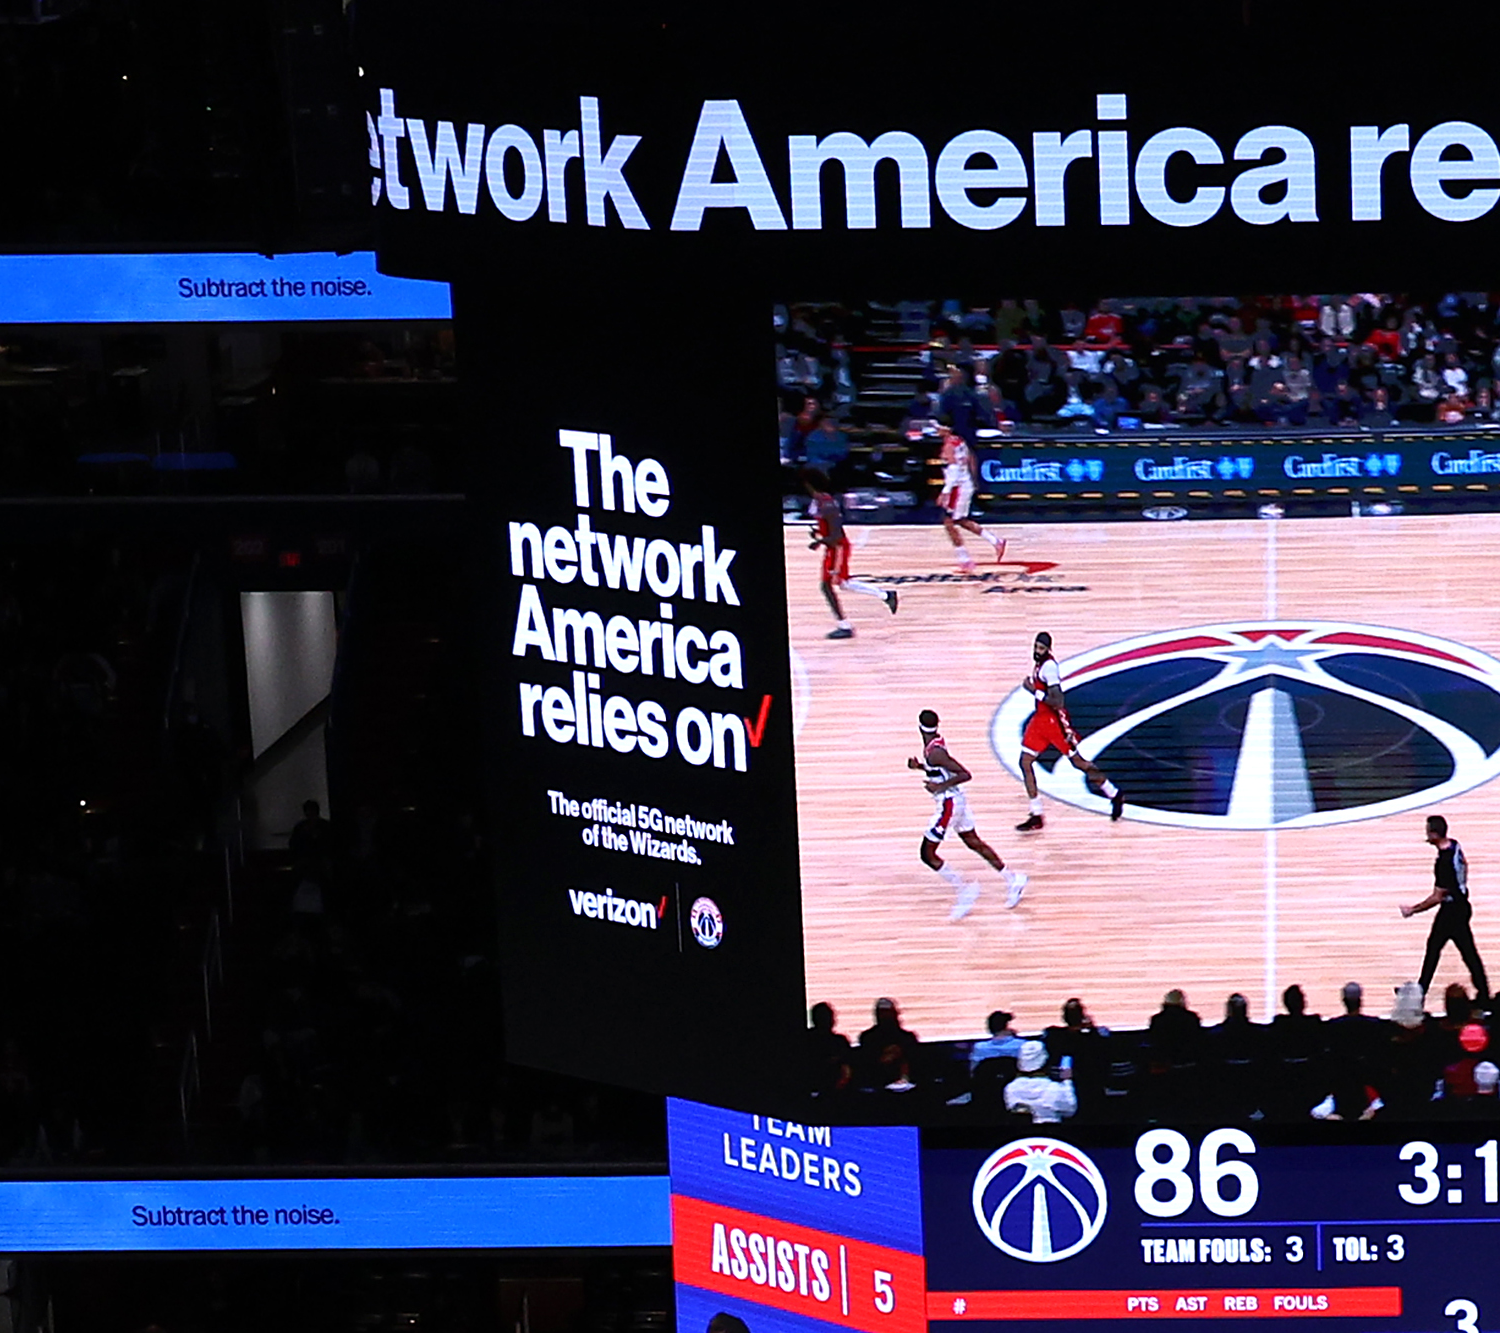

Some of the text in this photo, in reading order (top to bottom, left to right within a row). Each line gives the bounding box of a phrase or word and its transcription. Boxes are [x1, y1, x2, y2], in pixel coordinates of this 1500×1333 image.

[670, 93, 1319, 231] America
[178, 276, 372, 299] Subtract the noise.
[559, 429, 670, 517] The
[509, 514, 740, 606] network
[512, 583, 743, 689] America
[520, 670, 747, 772] relies on
[547, 790, 735, 845] The official 5G network
[582, 827, 701, 865] of the Wizards.
[569, 888, 657, 929] verizon
[724, 1132, 862, 1197] LEADERS
[1134, 1128, 1259, 1218] 86
[712, 1223, 894, 1313] ASSISTS 5
[1140, 1235, 1304, 1263] TEAM FOULS: 3
[1332, 1234, 1405, 1262] TOL: 3
